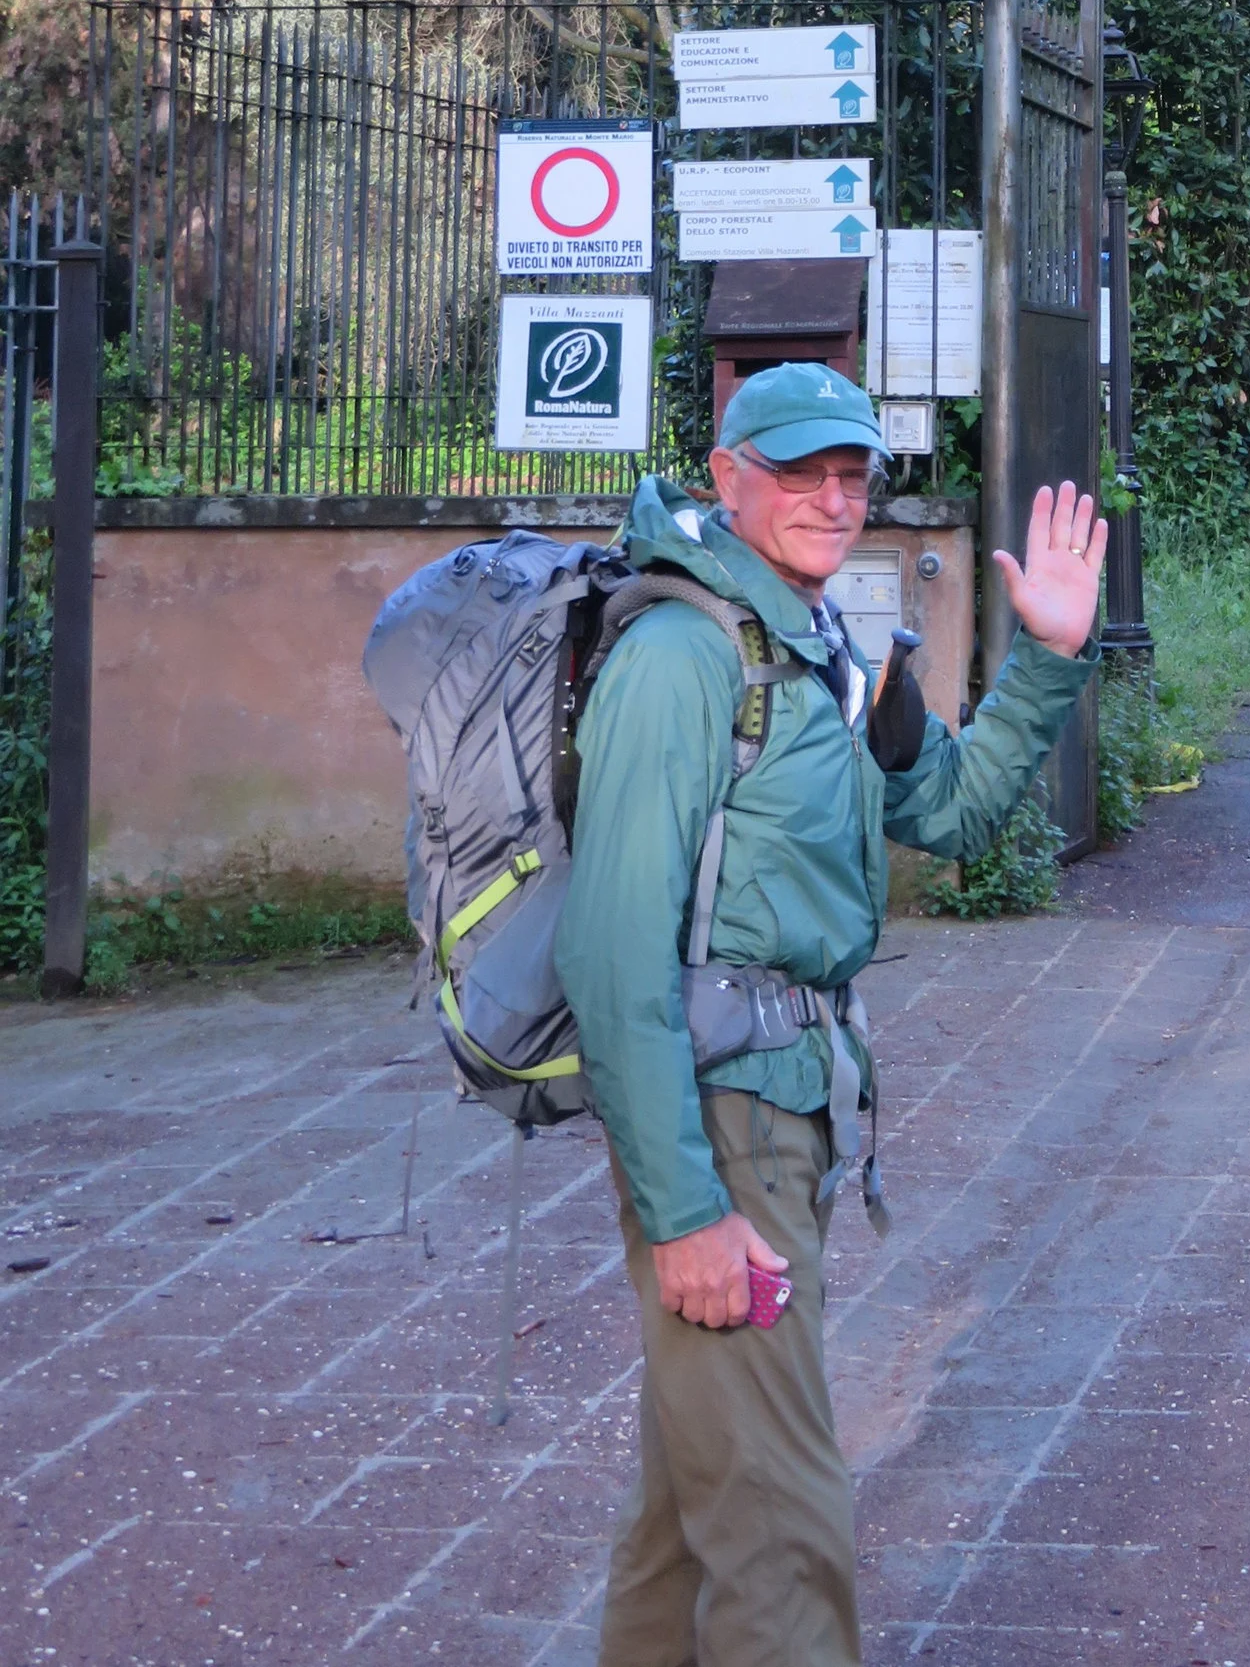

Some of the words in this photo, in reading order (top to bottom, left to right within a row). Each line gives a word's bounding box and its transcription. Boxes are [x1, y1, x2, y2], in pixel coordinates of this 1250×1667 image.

[681, 37, 720, 45] SETTORE
[681, 47, 740, 56] EDUCAZIONE
[681, 57, 760, 67] COMUNICAZIONE
[686, 85, 726, 94] SETTORE
[686, 95, 769, 105] AMMINISTRATIVO
[679, 166, 710, 175] U.R.P.
[724, 166, 771, 174] ECOPOINT
[686, 216, 717, 225] CORPO
[721, 216, 773, 224] FORESTALE
[686, 228, 715, 236] DELLO
[719, 227, 749, 235] STATO
[507, 241, 549, 254] DIVIETO
[552, 241, 563, 253] DI
[567, 240, 618, 253] TRANSITO
[622, 240, 643, 252] PER
[507, 256, 548, 269] VEICOLI
[551, 256, 572, 268] NON
[576, 255, 643, 268] AUTORIZZATI
[530, 306, 559, 318] Villa
[564, 307, 625, 319] Mazzanti
[534, 400, 612, 414] RomaNatura
